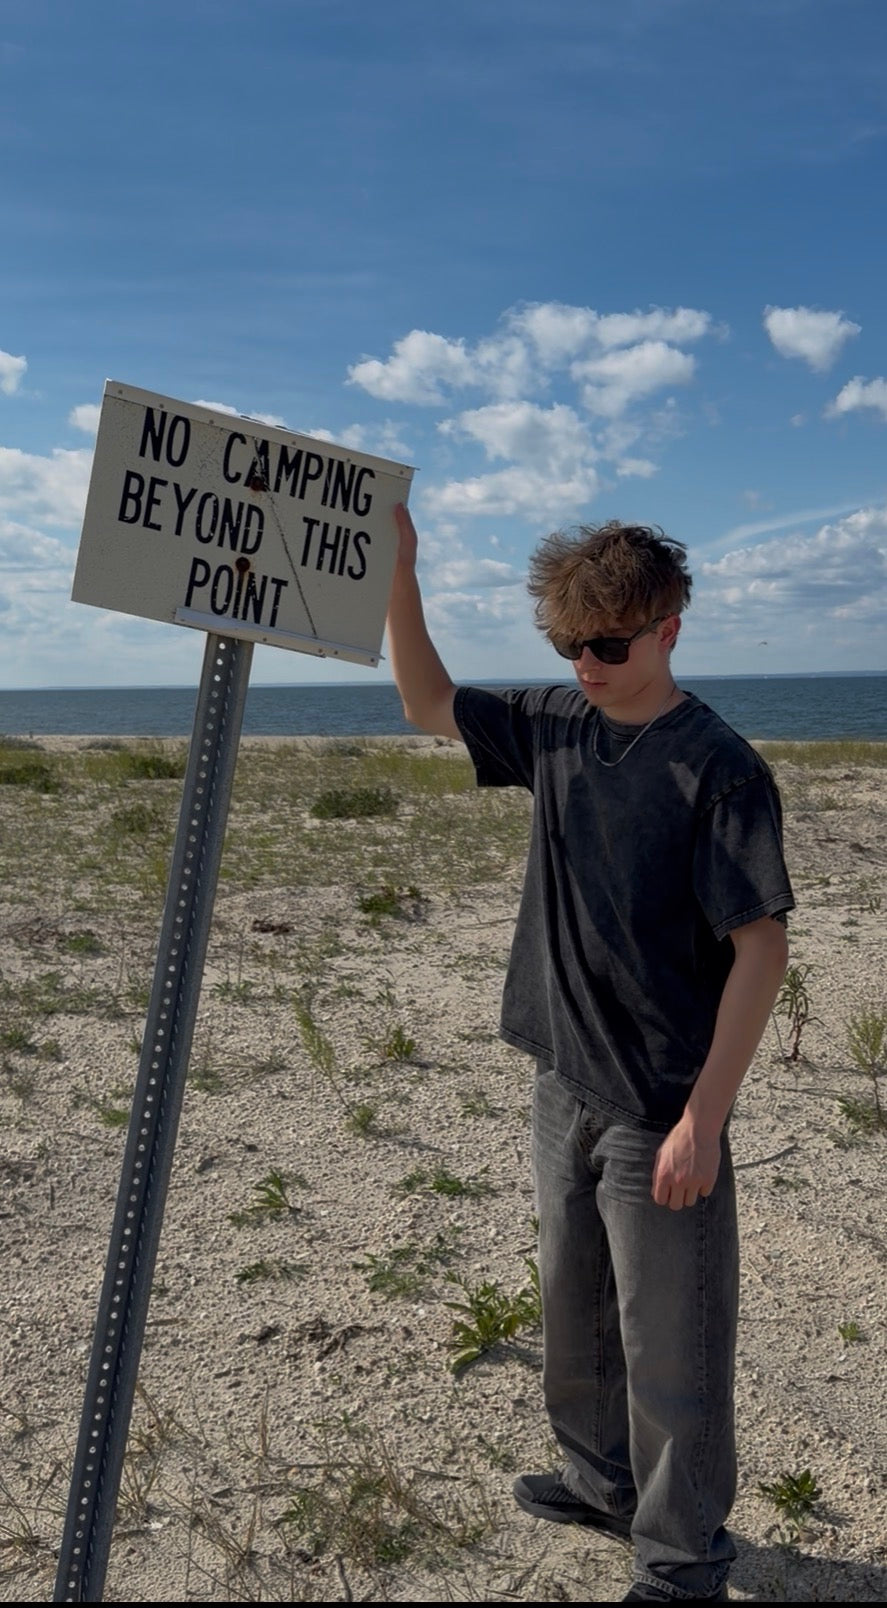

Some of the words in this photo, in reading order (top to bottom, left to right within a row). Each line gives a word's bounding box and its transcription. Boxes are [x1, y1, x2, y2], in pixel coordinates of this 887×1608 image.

[138, 407, 191, 467] NO
[222, 431, 376, 517] CAMPING
[118, 469, 265, 555] BEYOND
[300, 516, 371, 580] THIS
[184, 557, 288, 628] POINT
